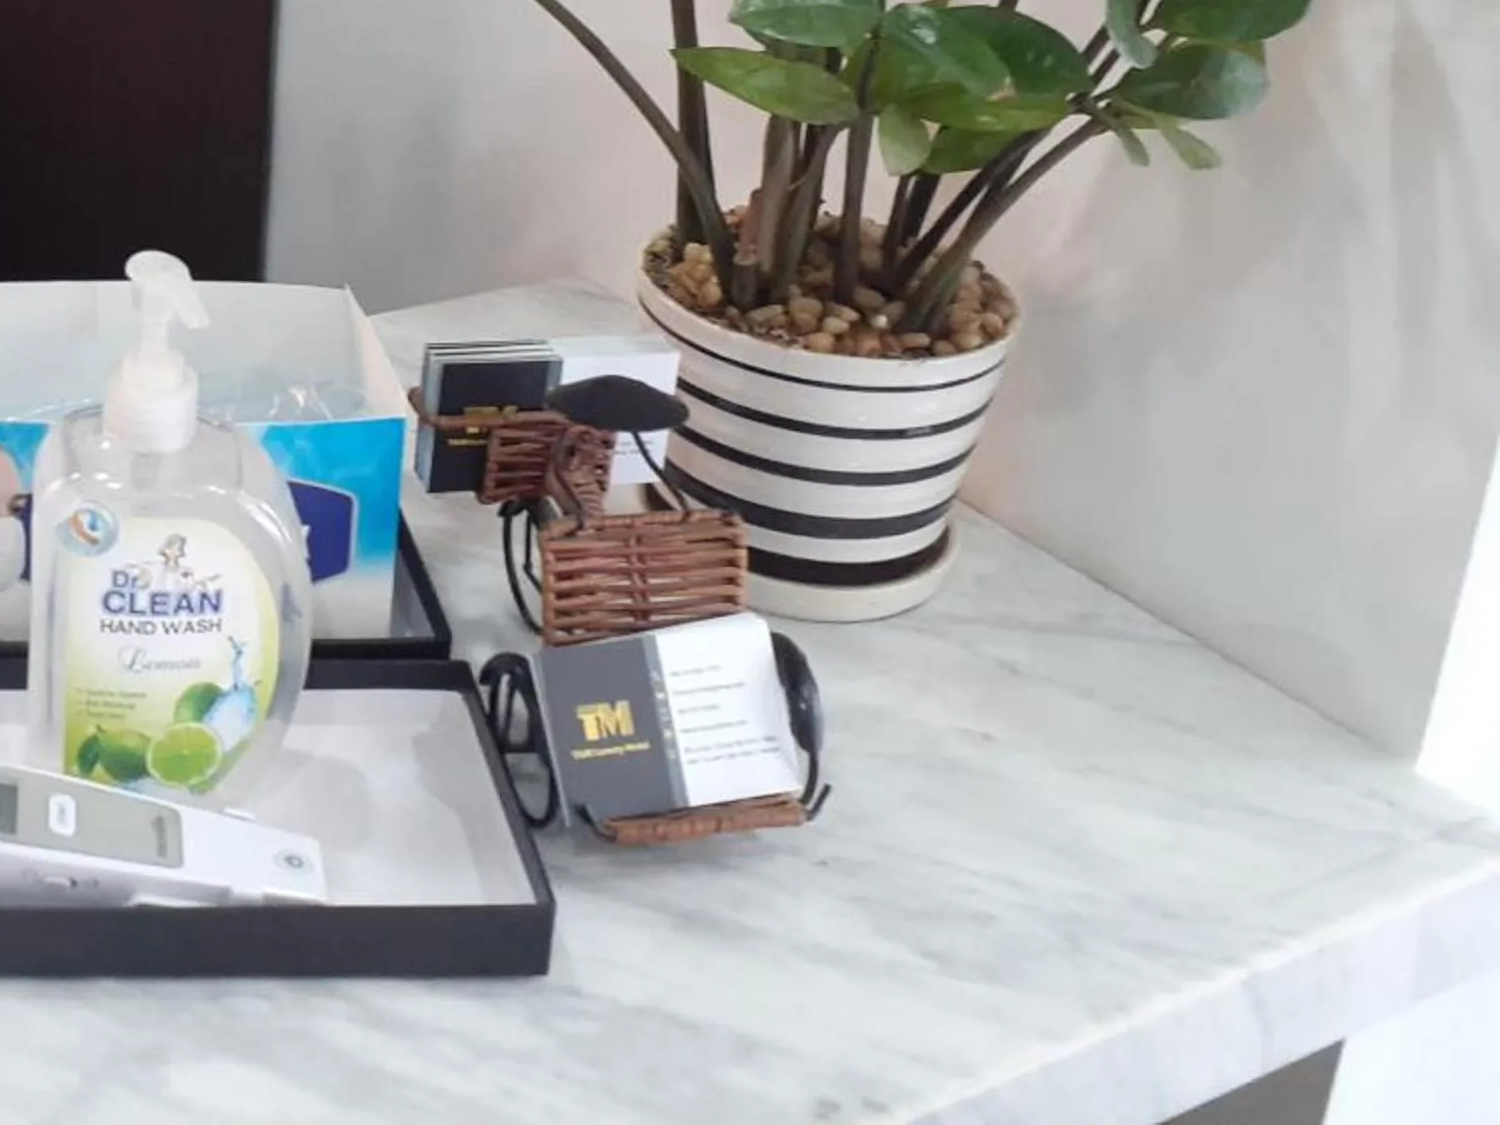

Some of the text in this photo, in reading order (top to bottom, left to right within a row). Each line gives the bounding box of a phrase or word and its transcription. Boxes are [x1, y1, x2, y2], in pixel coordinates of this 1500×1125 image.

[102, 589, 223, 616] CLEAN
[100, 617, 223, 636] HAND WASH
